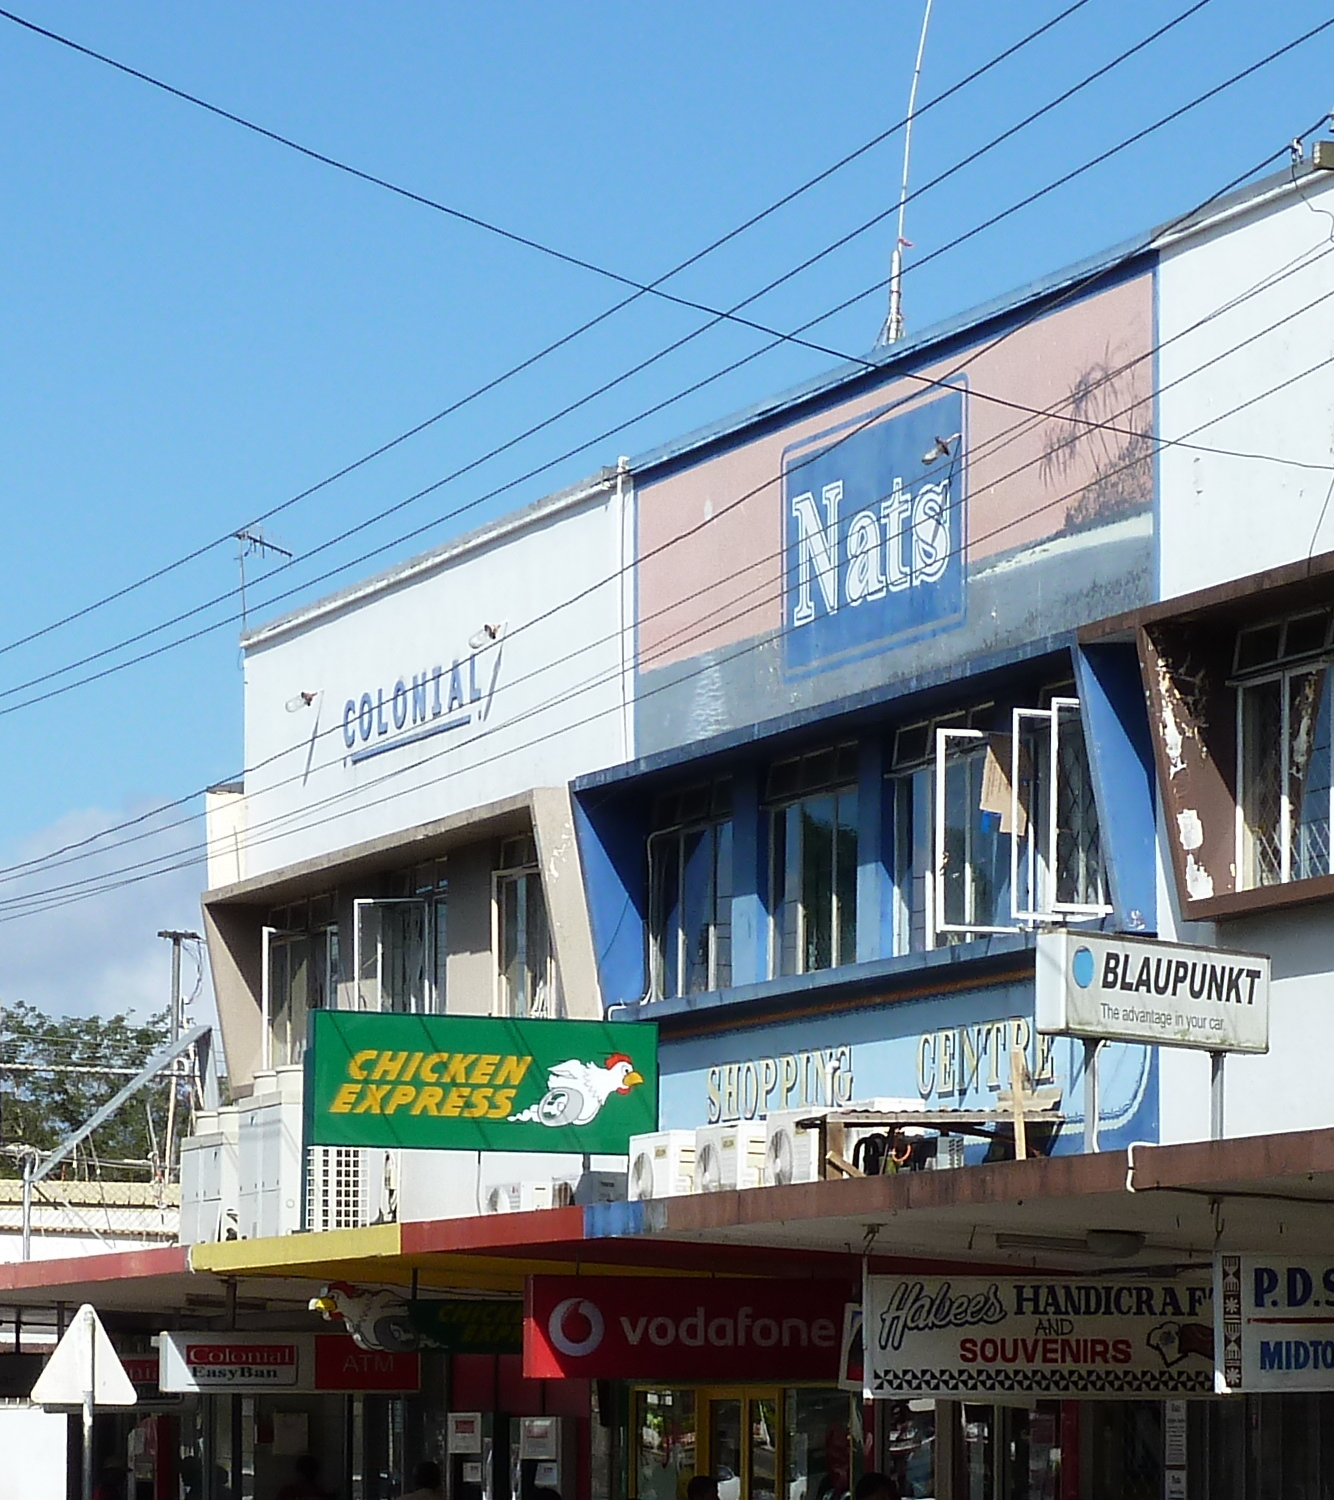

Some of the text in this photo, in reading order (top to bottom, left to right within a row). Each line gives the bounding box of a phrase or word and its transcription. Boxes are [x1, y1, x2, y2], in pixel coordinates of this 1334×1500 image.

[792, 477, 951, 626] Nats
[343, 653, 482, 748] COLONIAL
[1101, 952, 1261, 1005] BLAUPUNKT
[1100, 1003, 1119, 1020] The
[1122, 1006, 1172, 1028] advantage
[1175, 1011, 1184, 1027] in
[1185, 1015, 1207, 1031] your
[348, 1049, 532, 1086] CHICKEN
[707, 1016, 1055, 1124] SHOPPING CENTRE
[328, 1083, 517, 1119] EXPRESS
[1013, 1284, 1213, 1317] HANDICRAF
[620, 1305, 837, 1347] vodafone
[1035, 1318, 1075, 1336] AND
[189, 1347, 291, 1364] Colonial
[342, 1354, 394, 1374] ATM
[959, 1338, 1133, 1365] SOUVENIRS
